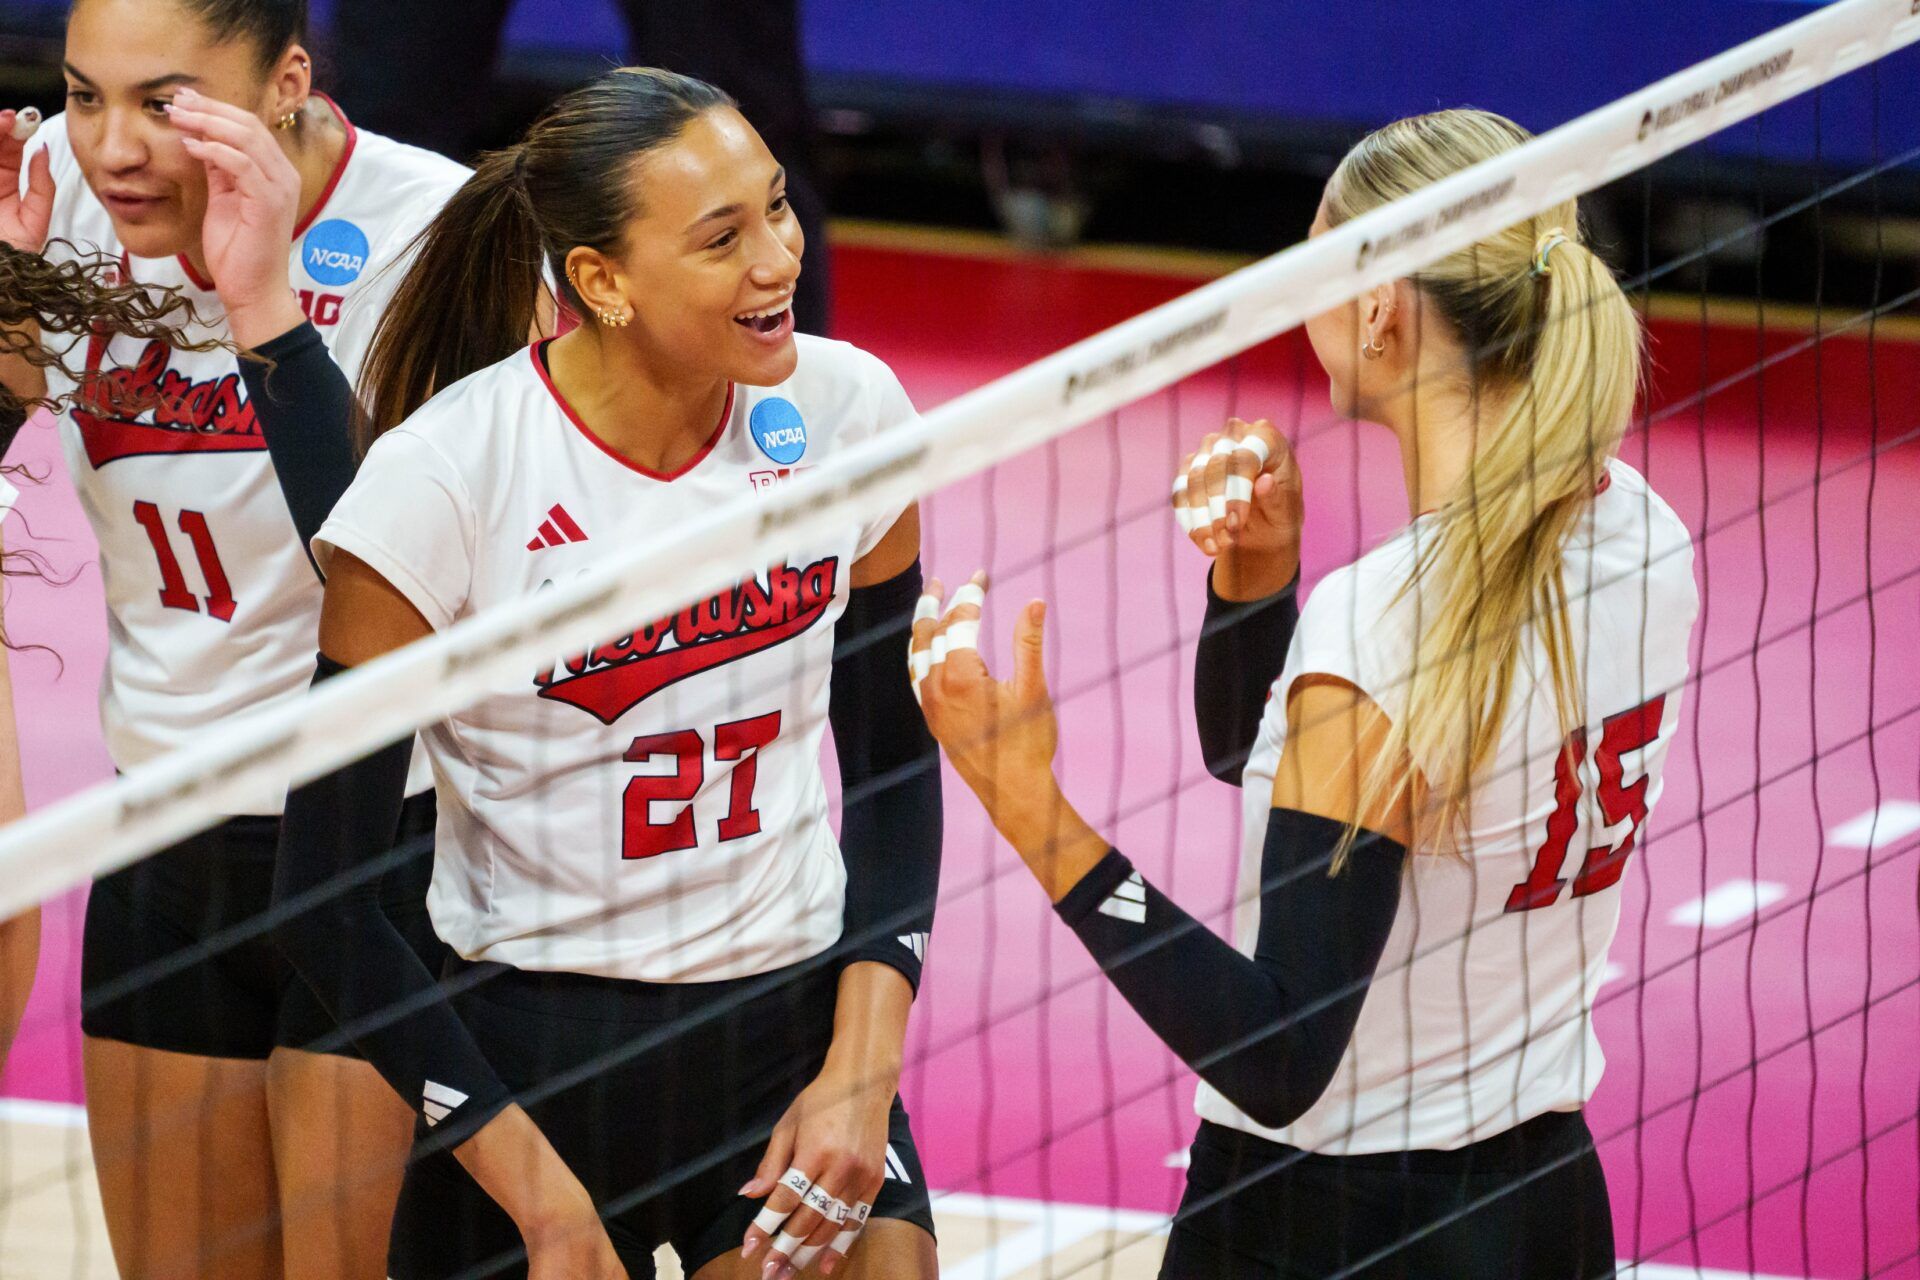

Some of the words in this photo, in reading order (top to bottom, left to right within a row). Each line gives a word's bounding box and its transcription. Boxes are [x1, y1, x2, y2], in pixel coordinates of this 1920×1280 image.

[308, 247, 363, 273] NCAA
[763, 426, 806, 449] NCAA
[132, 499, 238, 623] 11
[620, 709, 782, 860] 27
[1503, 692, 1667, 914] 15
